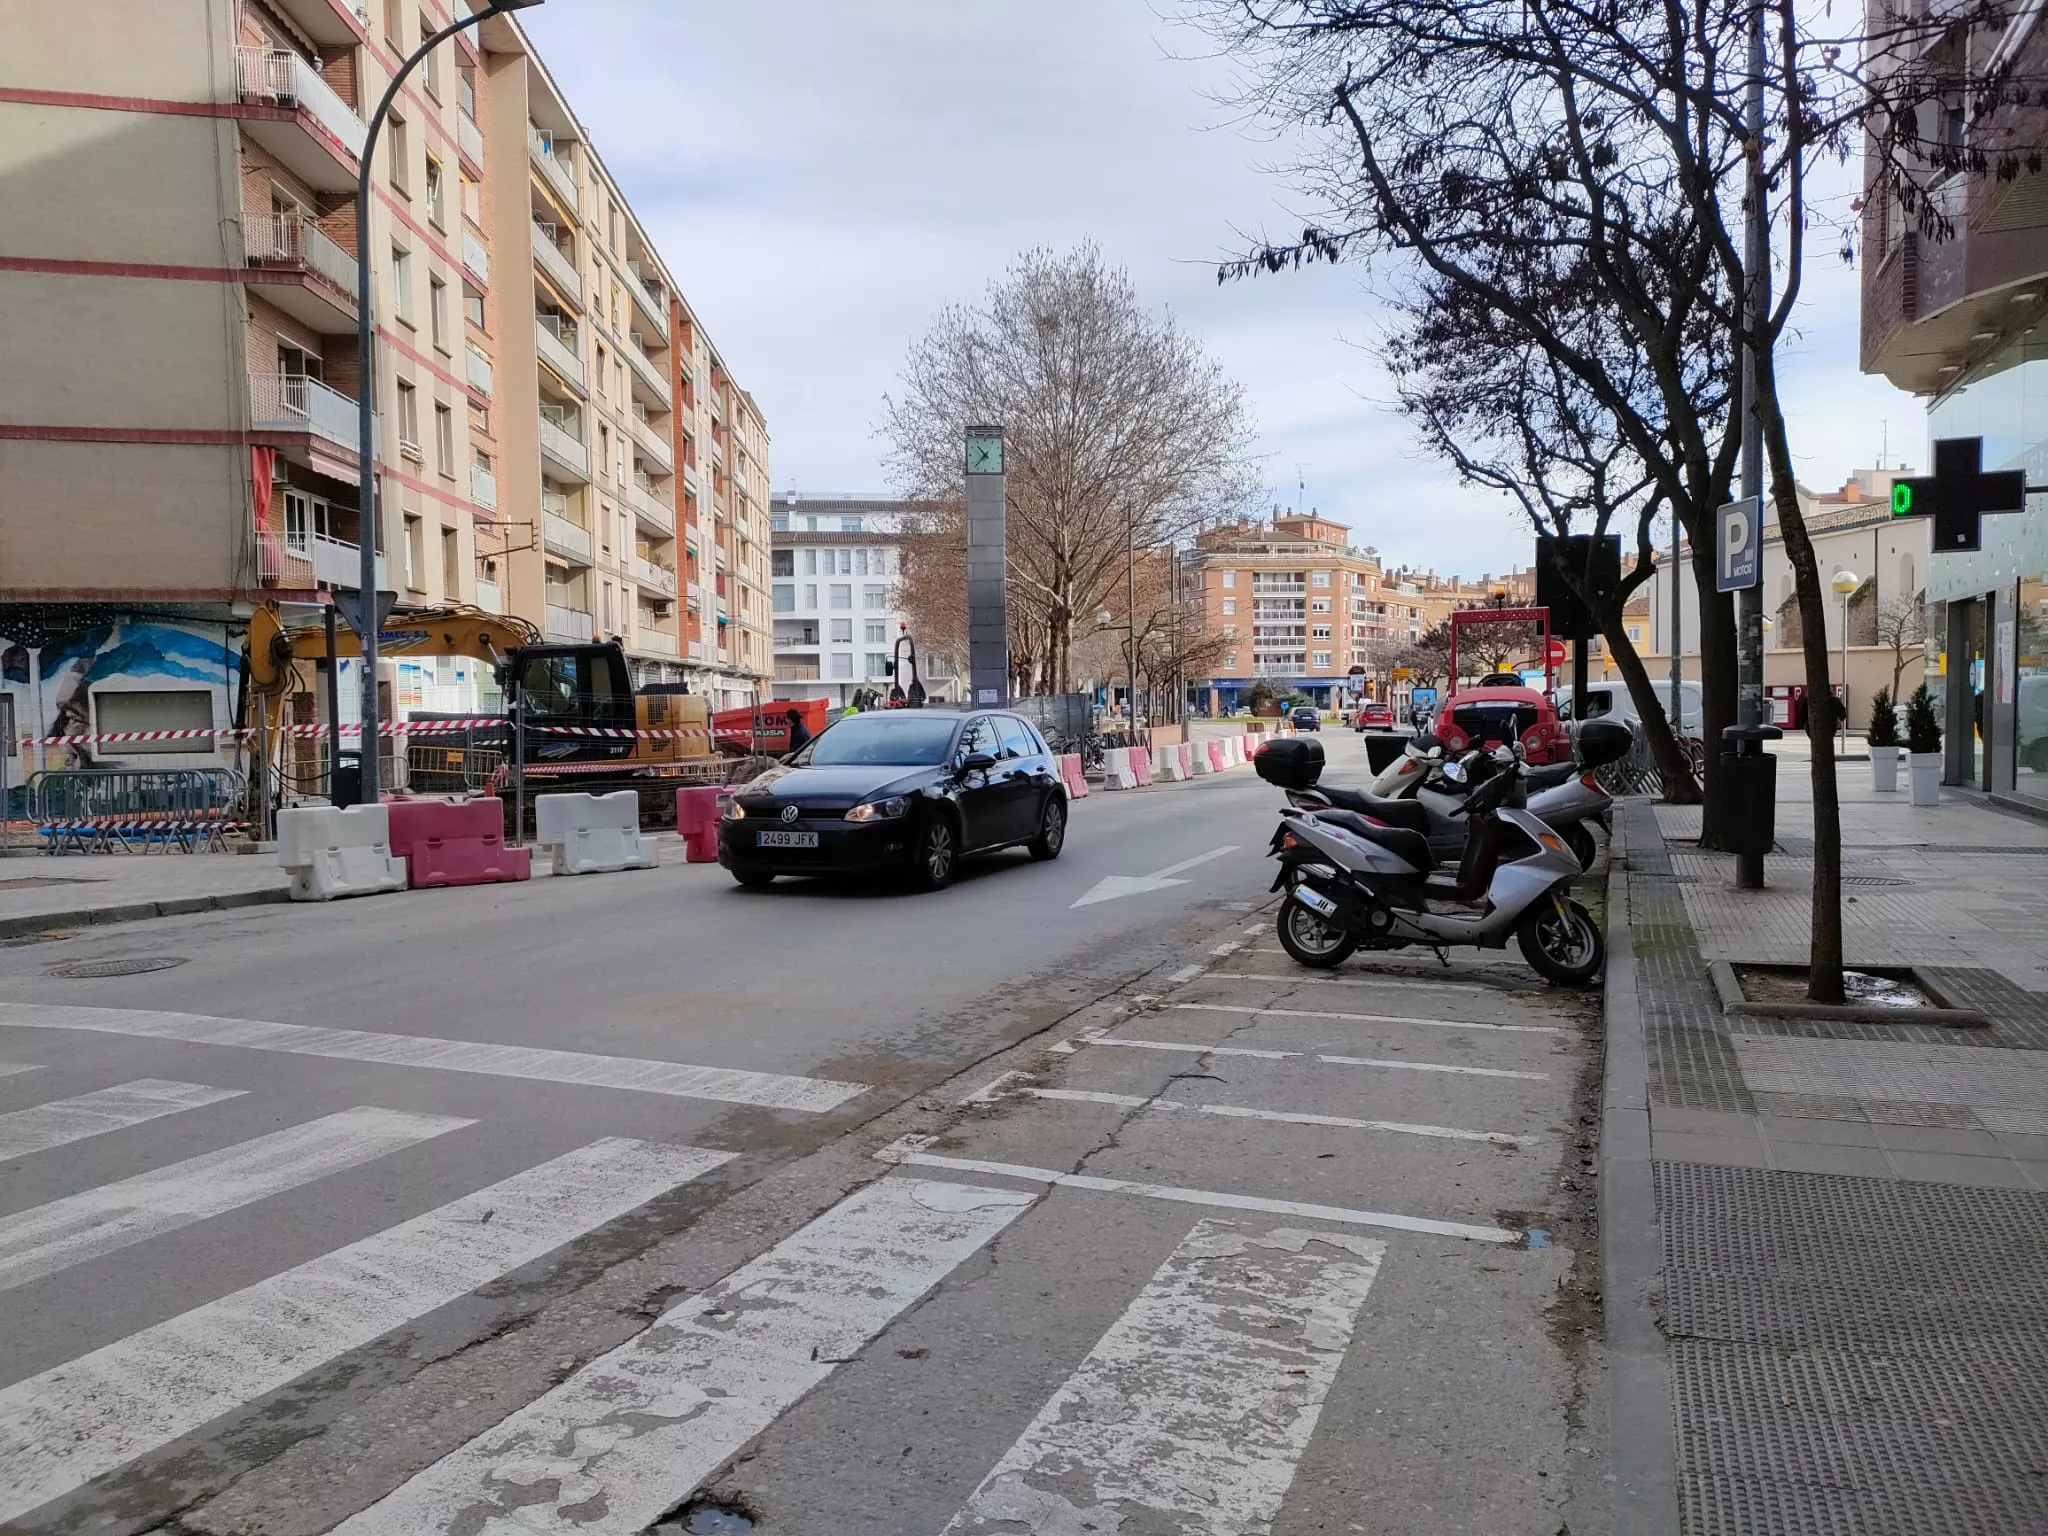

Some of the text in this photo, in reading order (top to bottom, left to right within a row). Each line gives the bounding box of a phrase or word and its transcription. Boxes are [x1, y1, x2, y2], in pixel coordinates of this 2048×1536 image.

[1725, 511, 1749, 579] P
[763, 833, 815, 846] 2499 JFK
